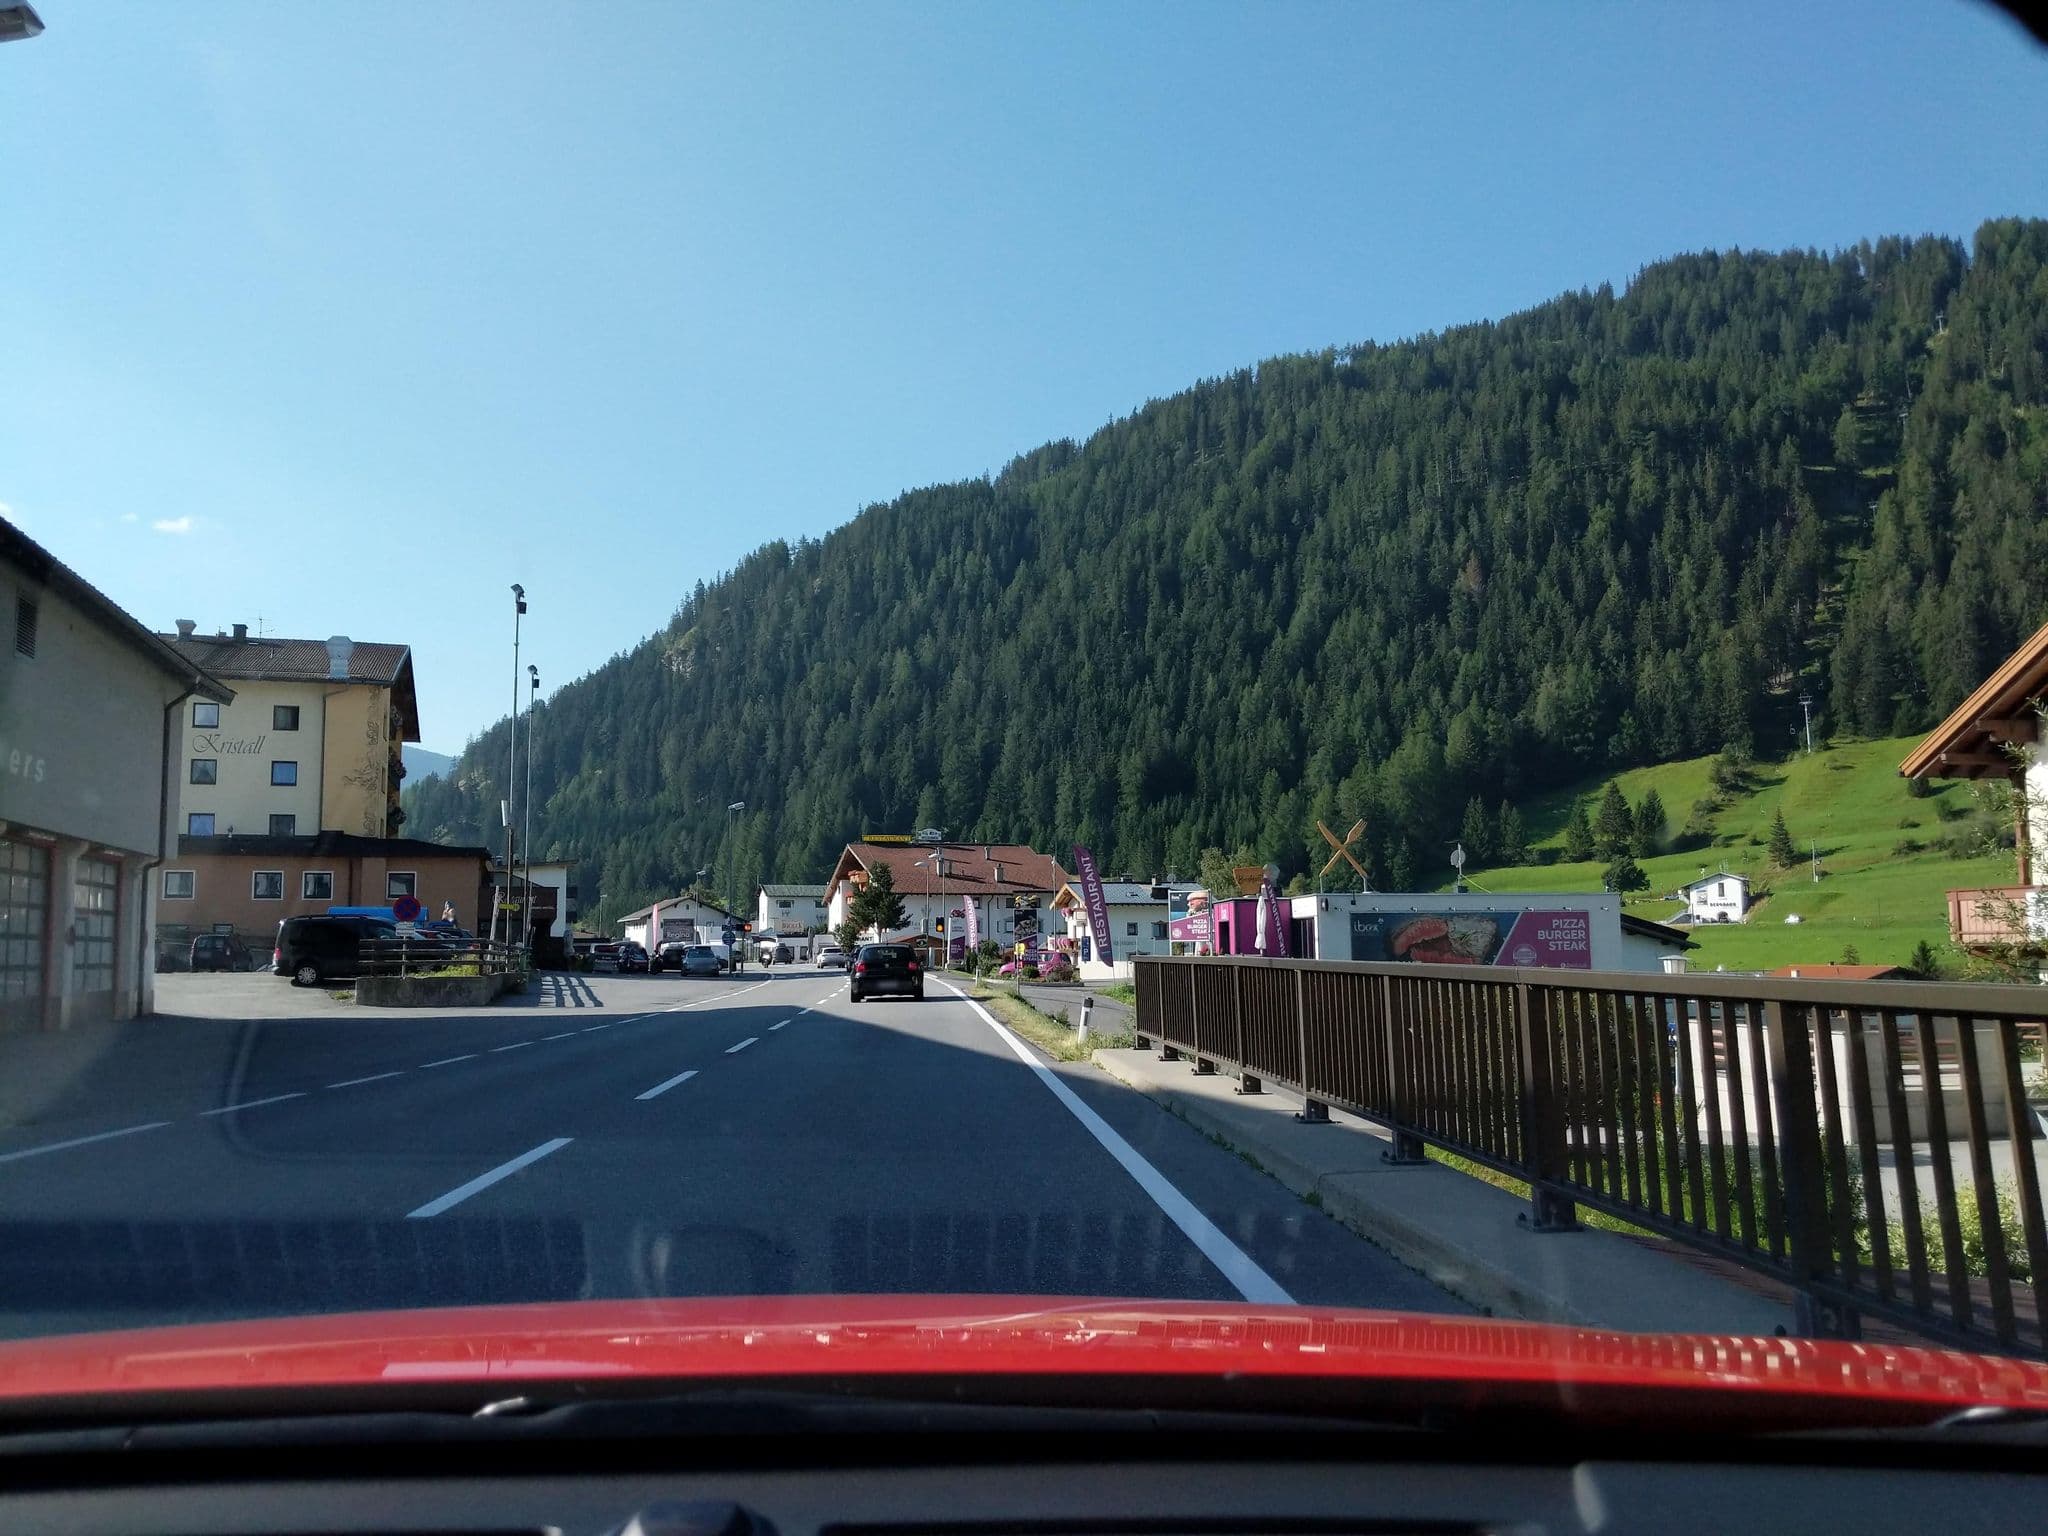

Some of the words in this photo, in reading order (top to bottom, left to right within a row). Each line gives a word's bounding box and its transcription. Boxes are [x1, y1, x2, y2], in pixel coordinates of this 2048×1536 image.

[192, 733, 266, 754] Kristall
[1081, 856, 1108, 947] RESTAURANT
[1552, 919, 1585, 929] PIZZA
[1537, 930, 1586, 940] BURGER
[1549, 941, 1587, 951] STEAK
